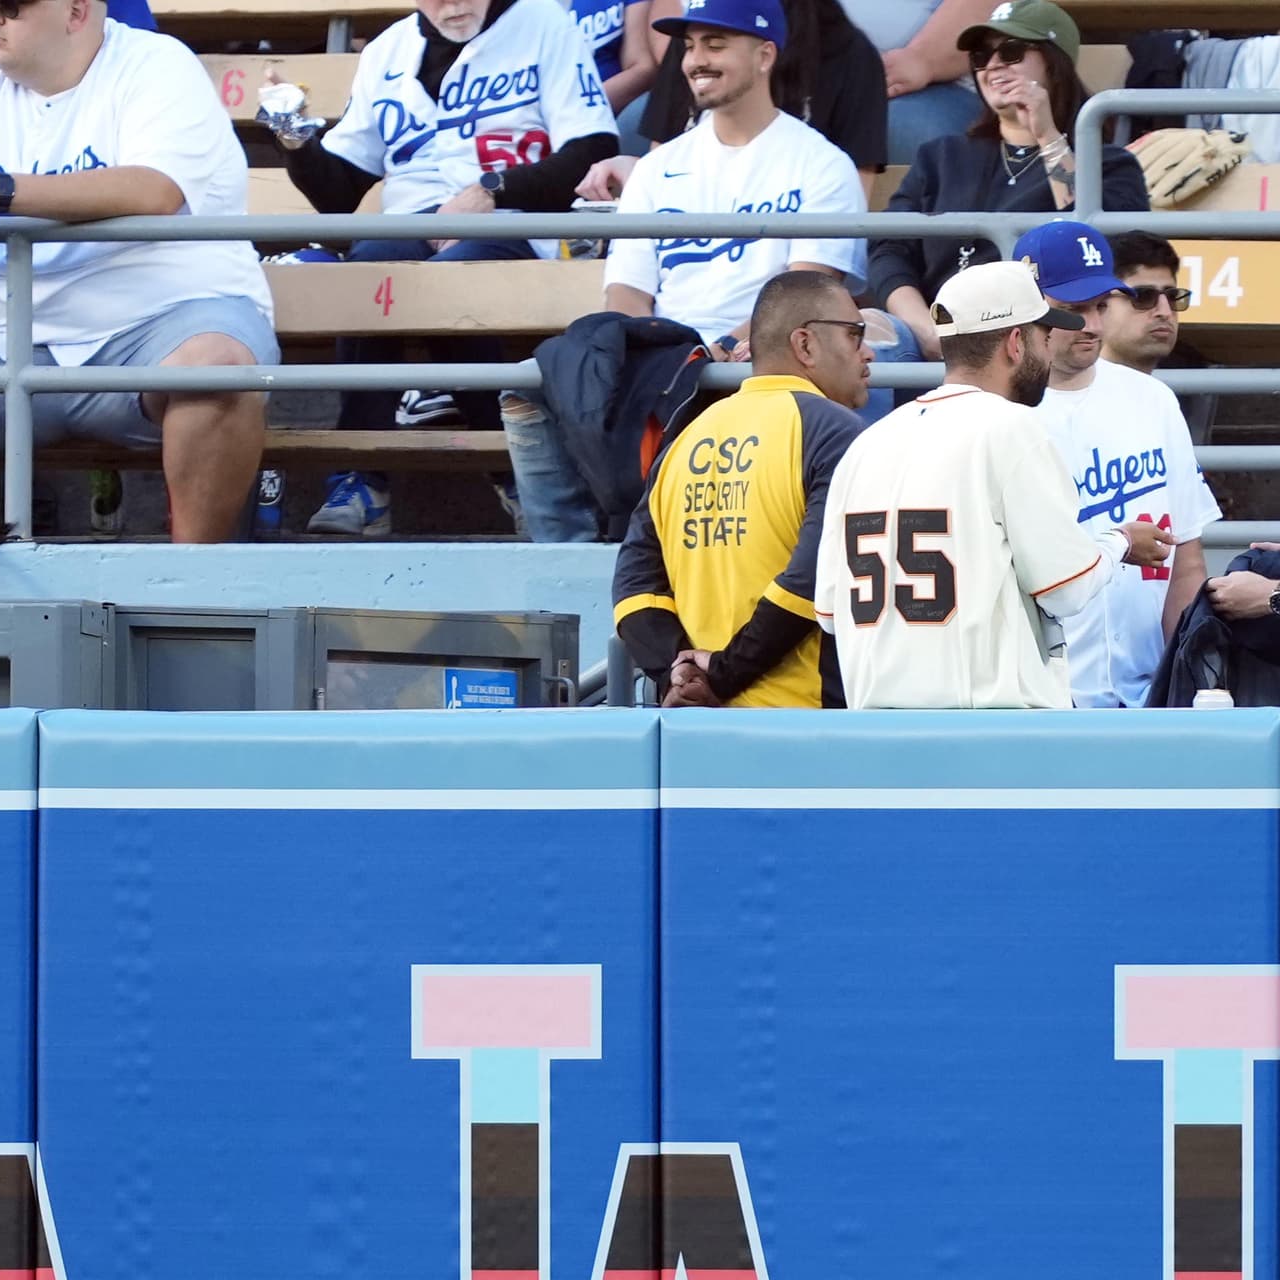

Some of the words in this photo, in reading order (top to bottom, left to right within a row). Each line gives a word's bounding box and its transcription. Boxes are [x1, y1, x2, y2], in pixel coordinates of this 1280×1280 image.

[221, 69, 245, 107] 6
[576, 63, 606, 106] LA
[1077, 237, 1103, 267] LA
[374, 276, 394, 317] 4
[1180, 255, 1244, 307] 14
[688, 435, 760, 475] CSC
[684, 481, 750, 513] SECURITY
[683, 516, 748, 549] STAFF
[843, 508, 960, 629] 55
